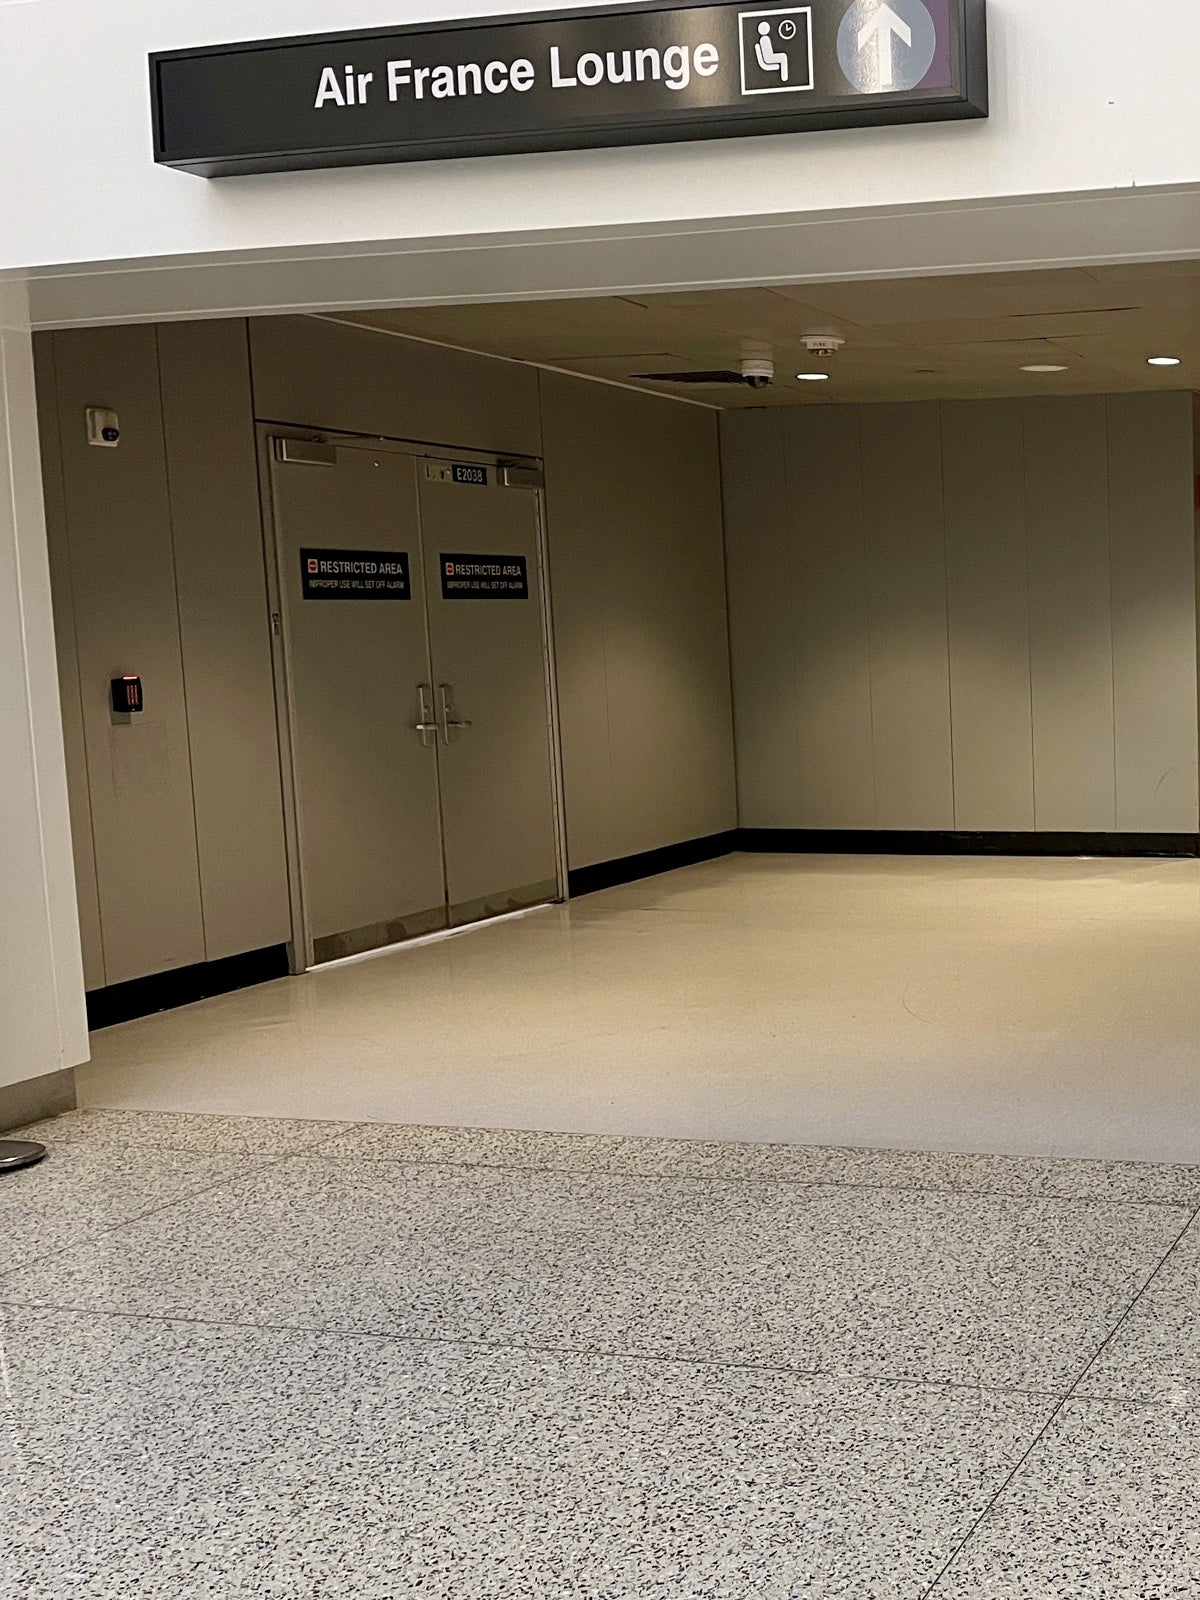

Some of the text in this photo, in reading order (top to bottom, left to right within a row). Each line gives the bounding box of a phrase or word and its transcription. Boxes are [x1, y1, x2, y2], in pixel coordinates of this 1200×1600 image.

[314, 43, 719, 108] Air France Lounge
[320, 560, 403, 575] RESTRICTED AREA
[455, 564, 522, 576] RESTRICTED AREA
[308, 579, 405, 589] IMPROPER USE WILL SET OFF ALARM
